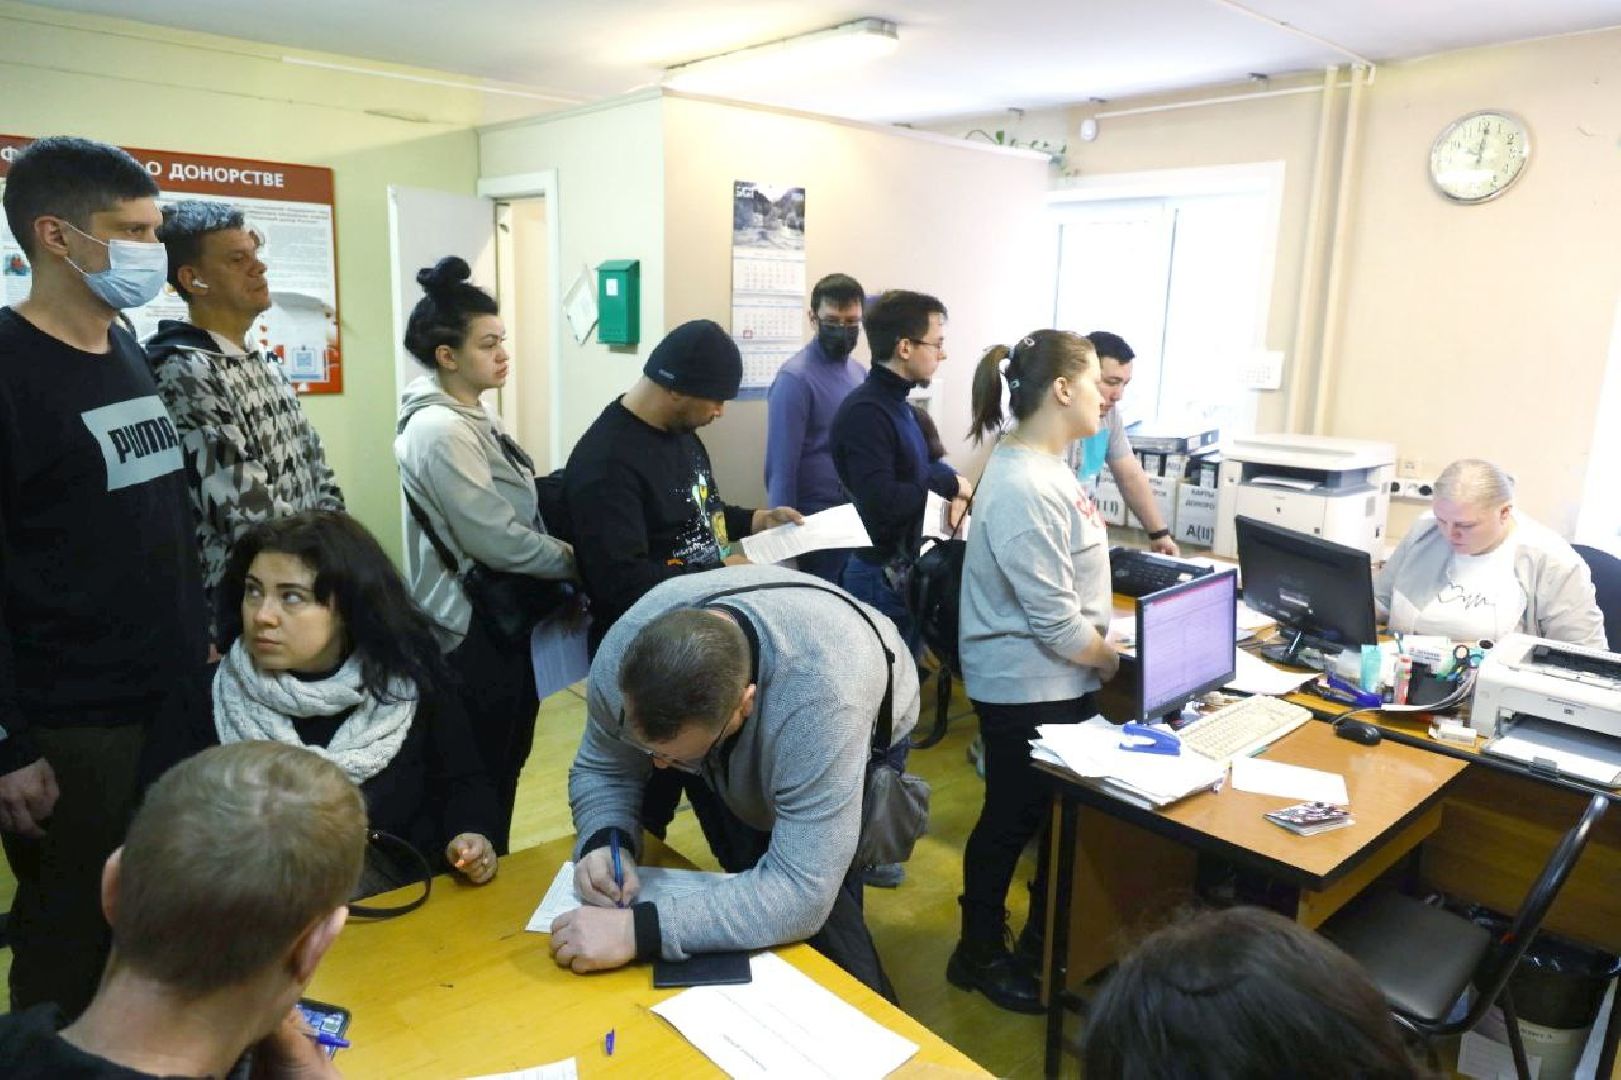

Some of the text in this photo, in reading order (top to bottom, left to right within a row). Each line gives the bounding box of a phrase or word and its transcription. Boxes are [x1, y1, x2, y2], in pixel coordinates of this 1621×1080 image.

[147, 161, 284, 188] О ДОНОРСТВЕ
[107, 415, 179, 464] PUMA
